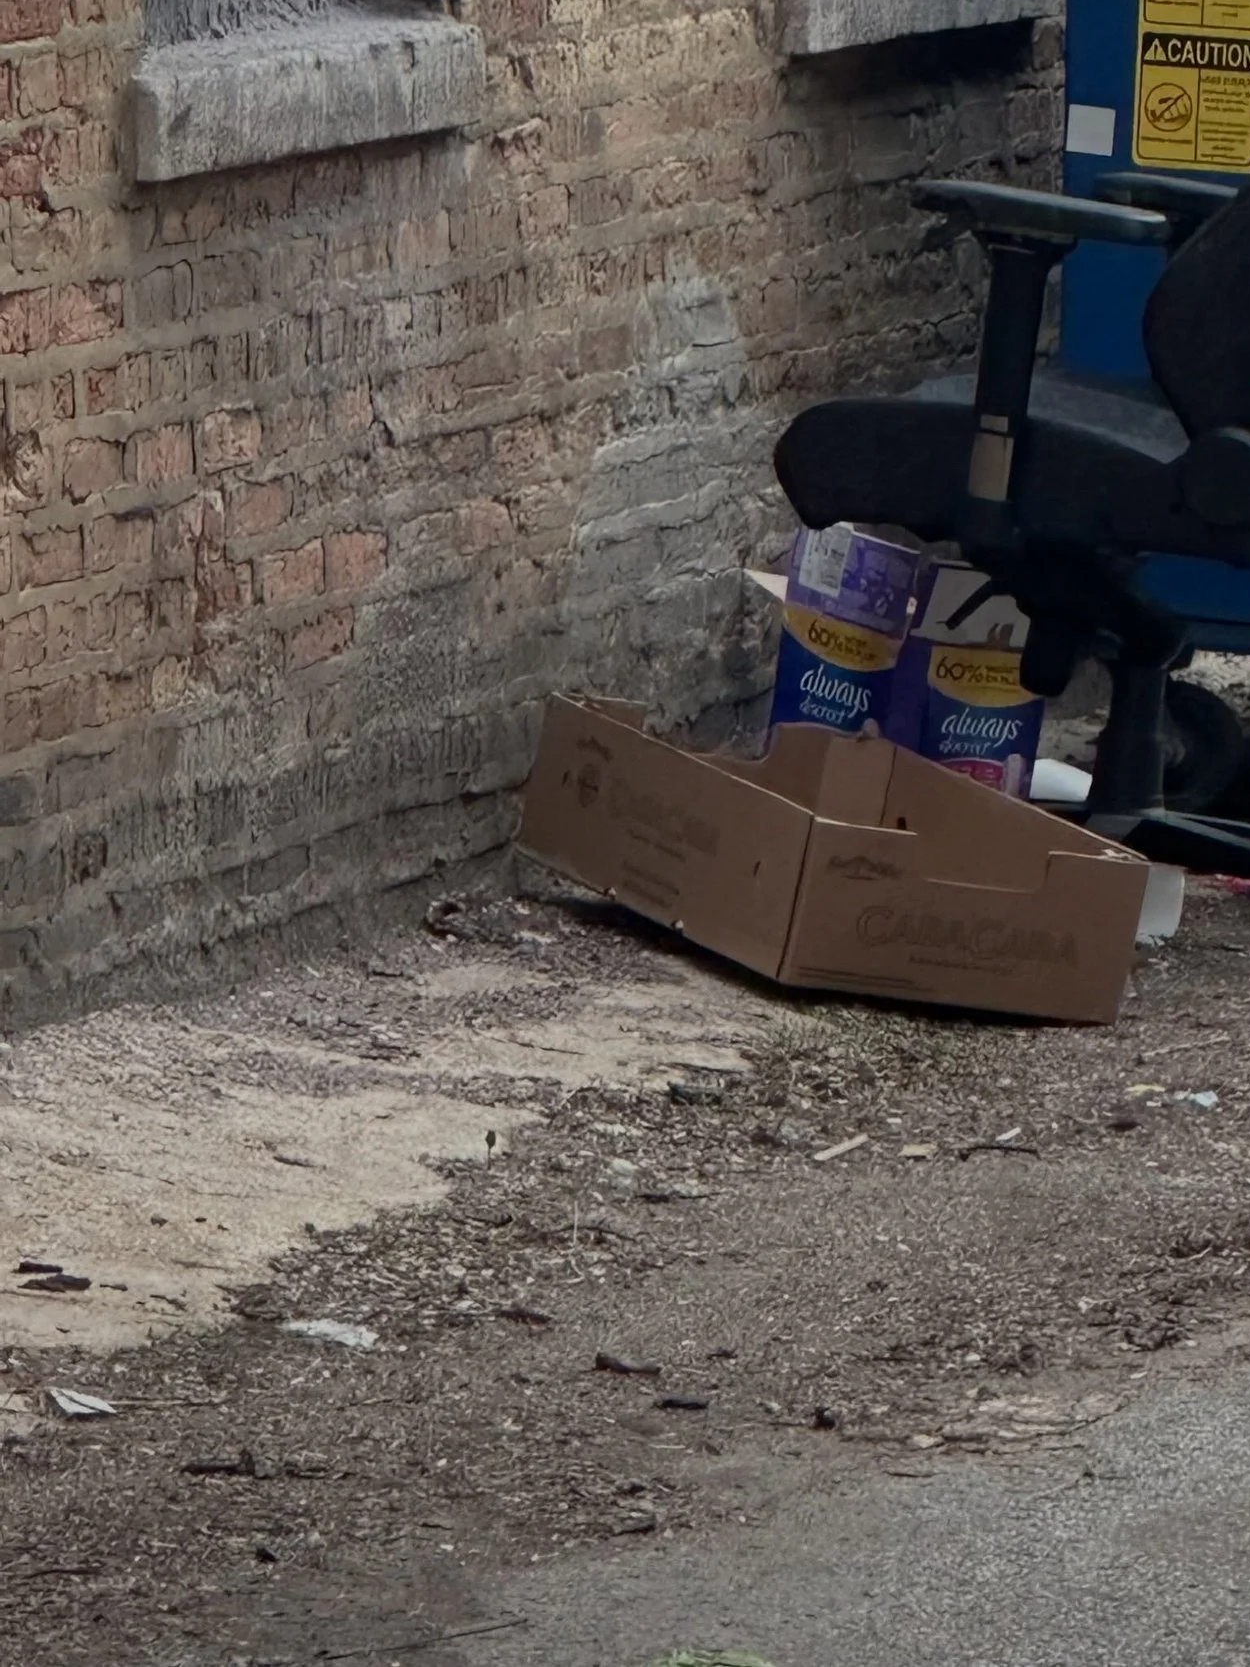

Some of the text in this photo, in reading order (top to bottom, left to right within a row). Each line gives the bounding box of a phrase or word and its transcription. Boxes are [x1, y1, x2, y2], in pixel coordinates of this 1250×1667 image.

[800, 663, 872, 718] always
[936, 656, 984, 683] 60%
[941, 706, 1023, 748] always
